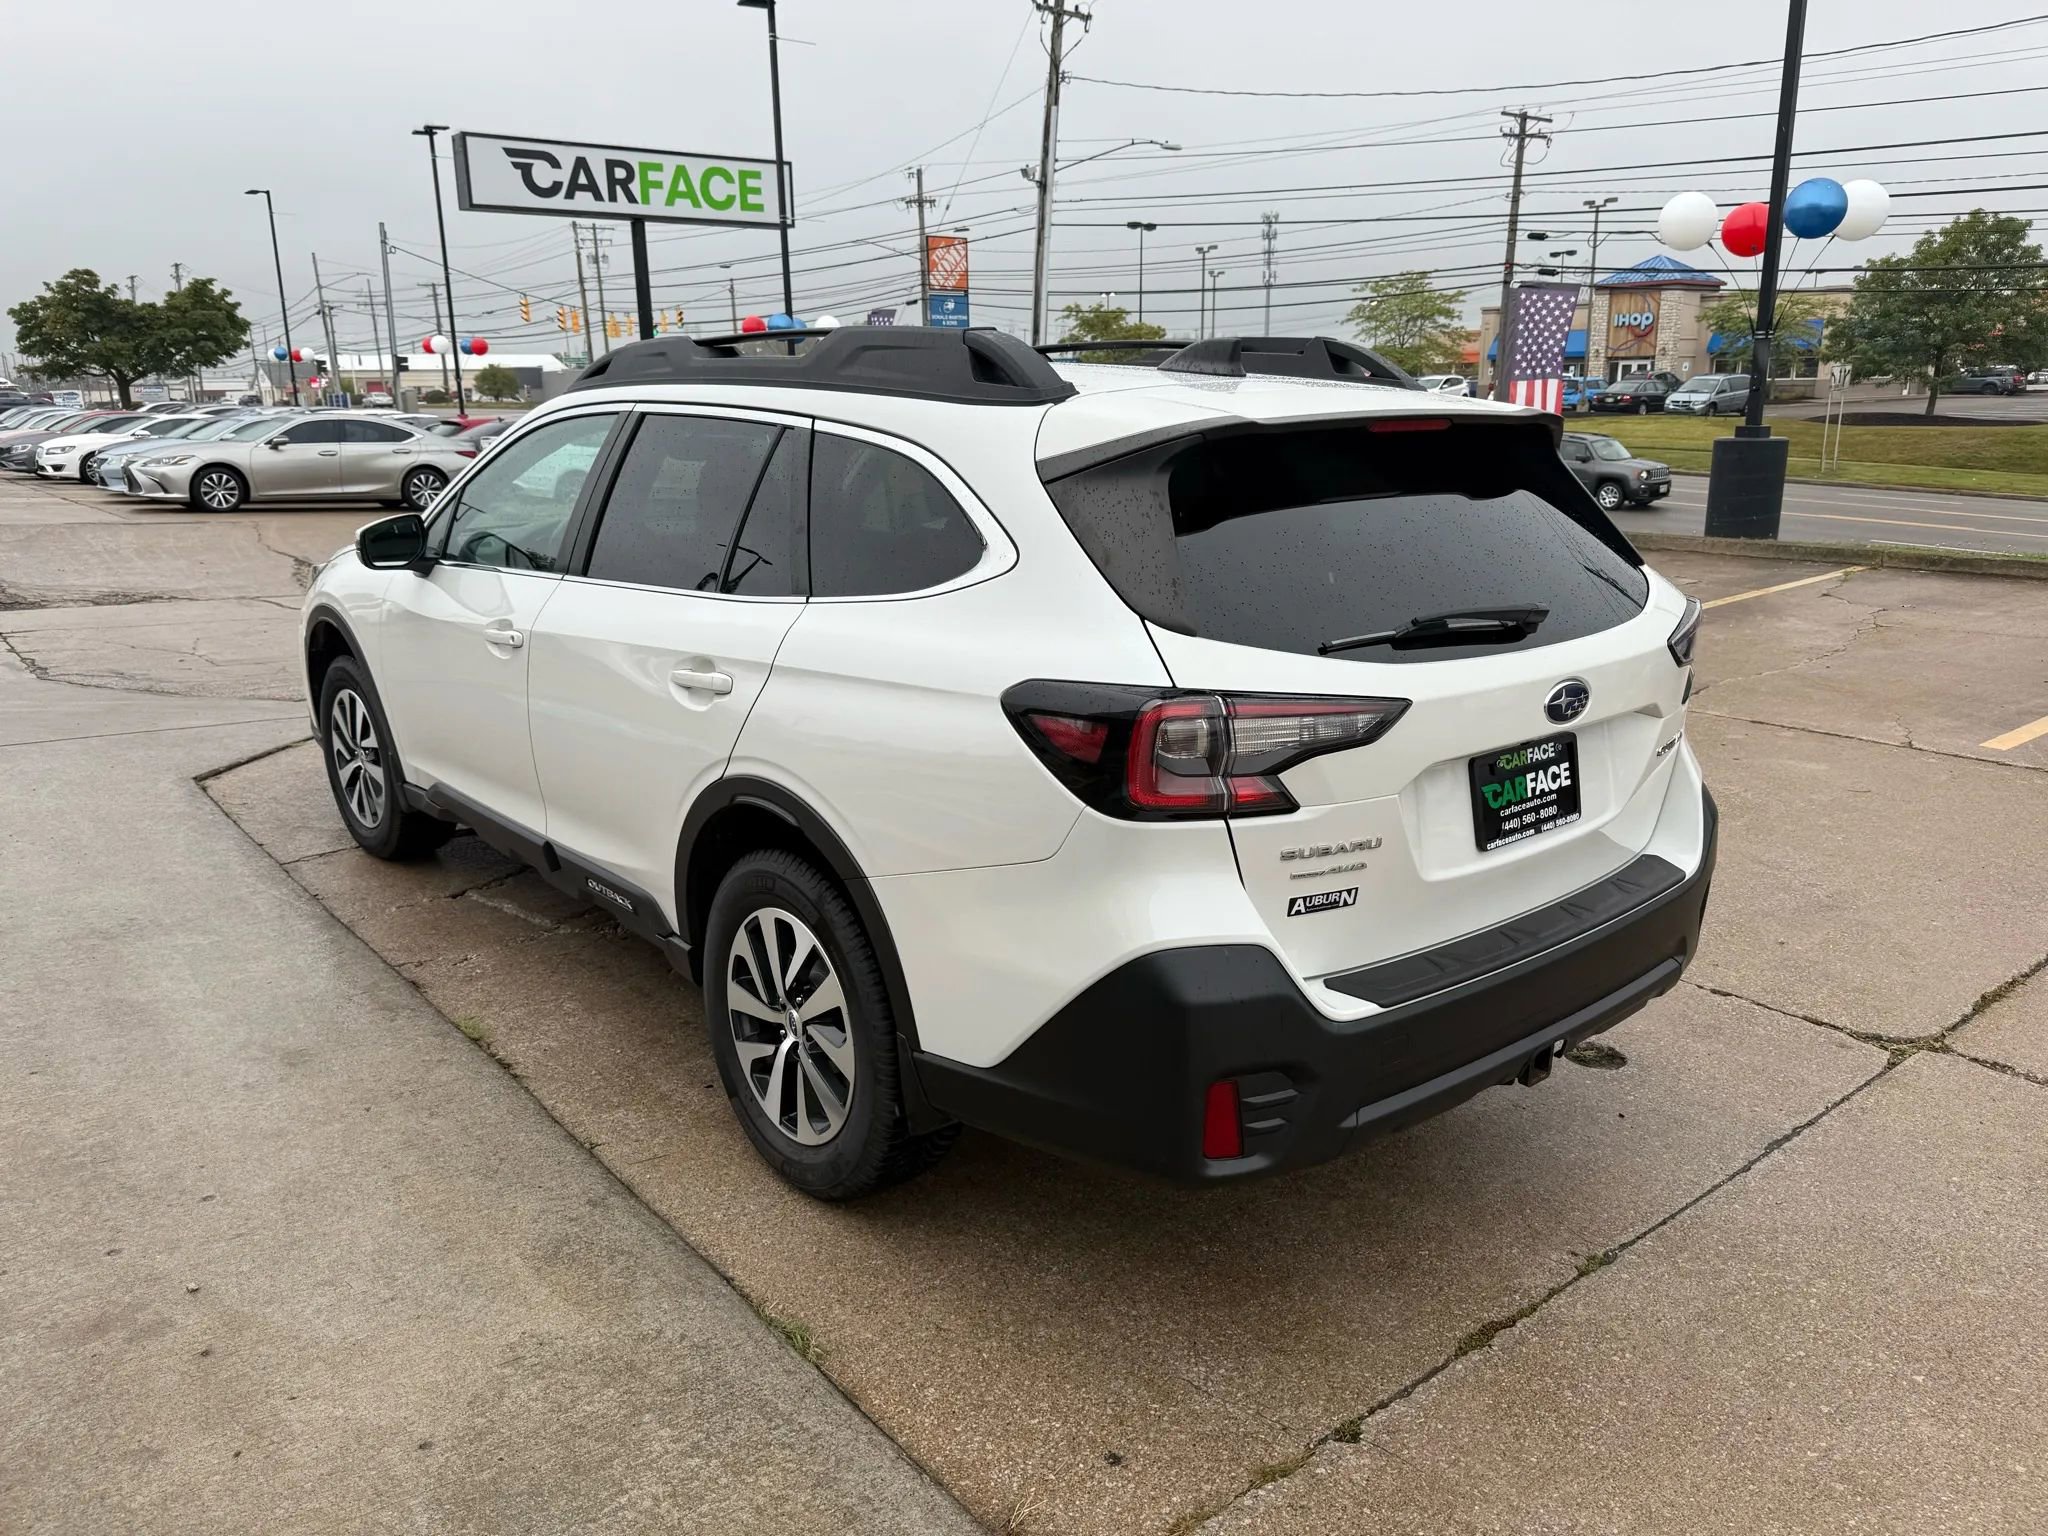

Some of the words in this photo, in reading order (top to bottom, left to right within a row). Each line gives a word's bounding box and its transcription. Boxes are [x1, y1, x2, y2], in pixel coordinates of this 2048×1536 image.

[500, 146, 766, 213] CARFACE
[1499, 742, 1556, 770] CARFACE
[1481, 762, 1571, 809] CARFACE
[1500, 793, 1557, 817] carfaceauto.com
[1501, 817, 1521, 831] (440)
[1280, 837, 1383, 861] SUBARU
[1486, 828, 1535, 850] carfaceauto.com
[587, 878, 633, 910] OUTBACK
